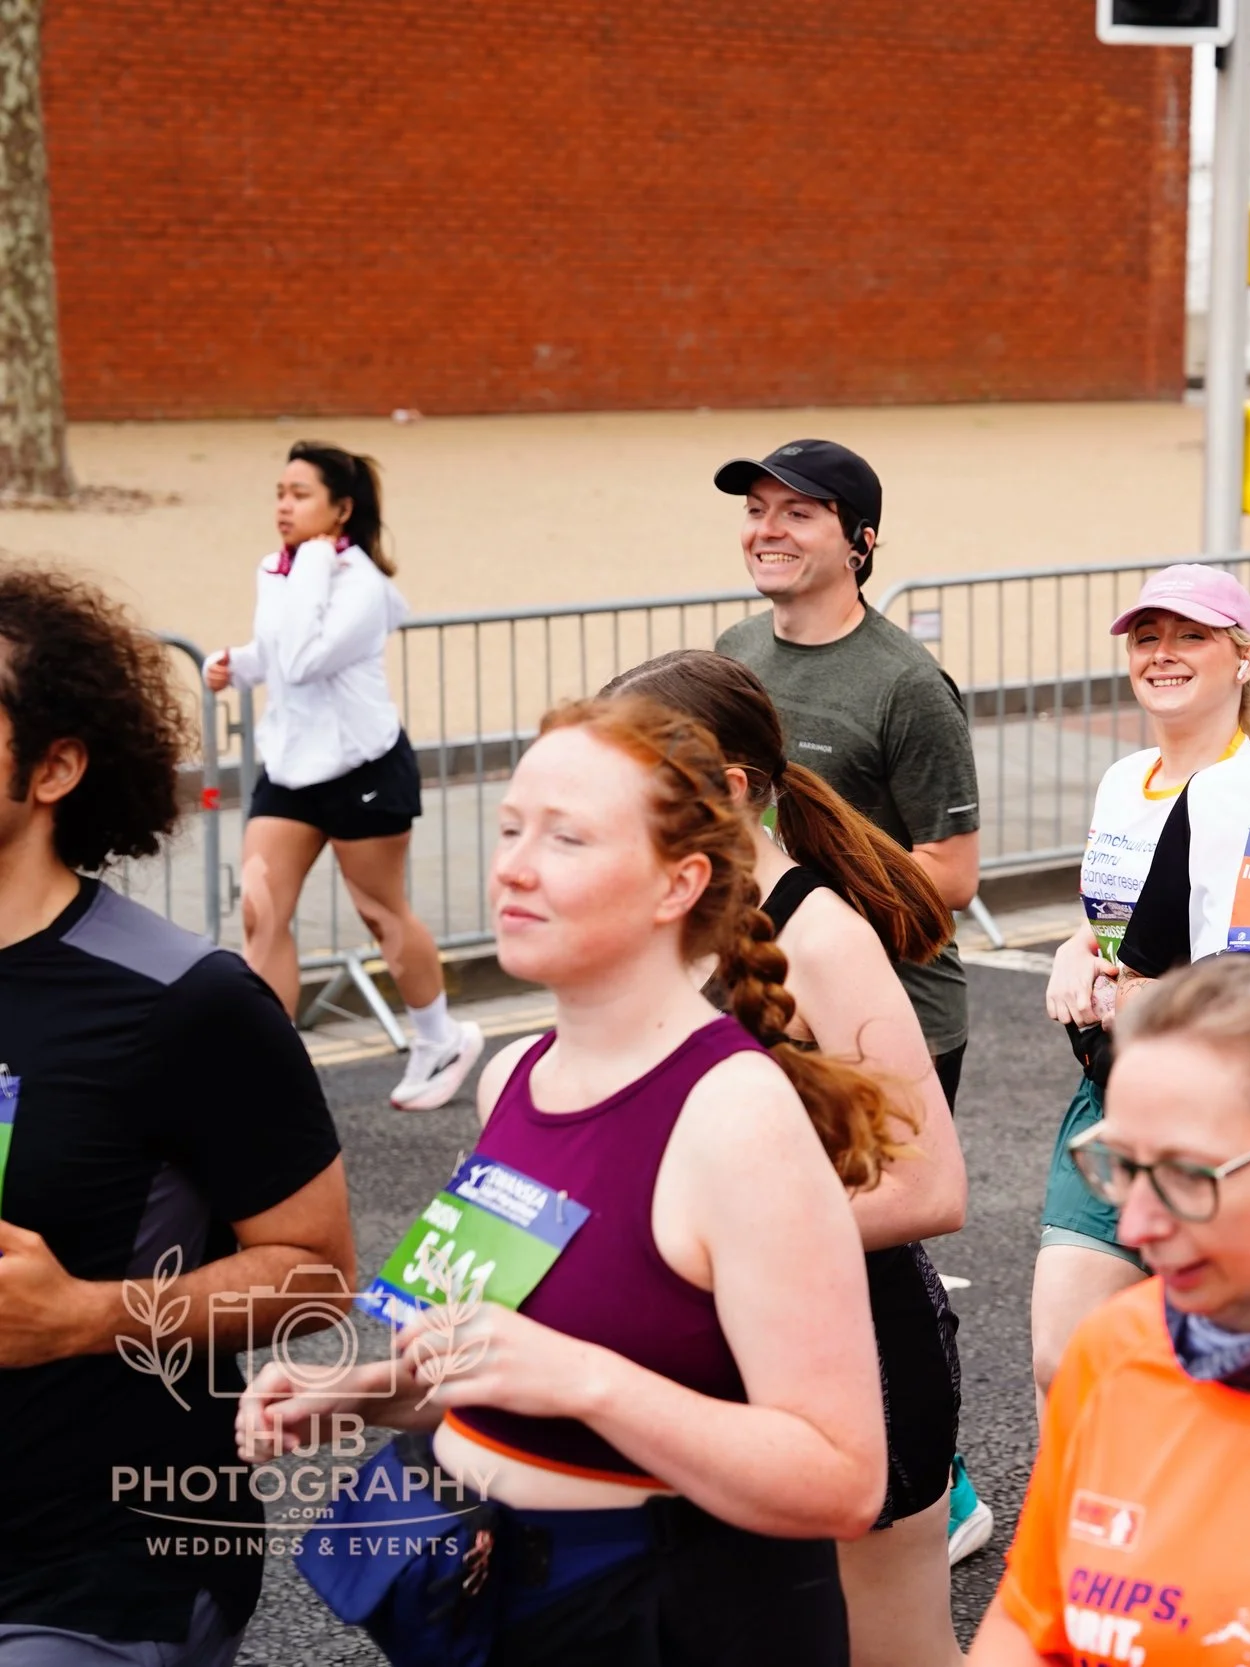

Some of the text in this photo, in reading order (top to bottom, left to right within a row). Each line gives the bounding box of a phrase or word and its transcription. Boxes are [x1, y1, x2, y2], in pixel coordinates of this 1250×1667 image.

[1087, 849, 1121, 866] cymru
[1083, 868, 1117, 886] cancer
[1070, 1568, 1190, 1629] CHIPS,
